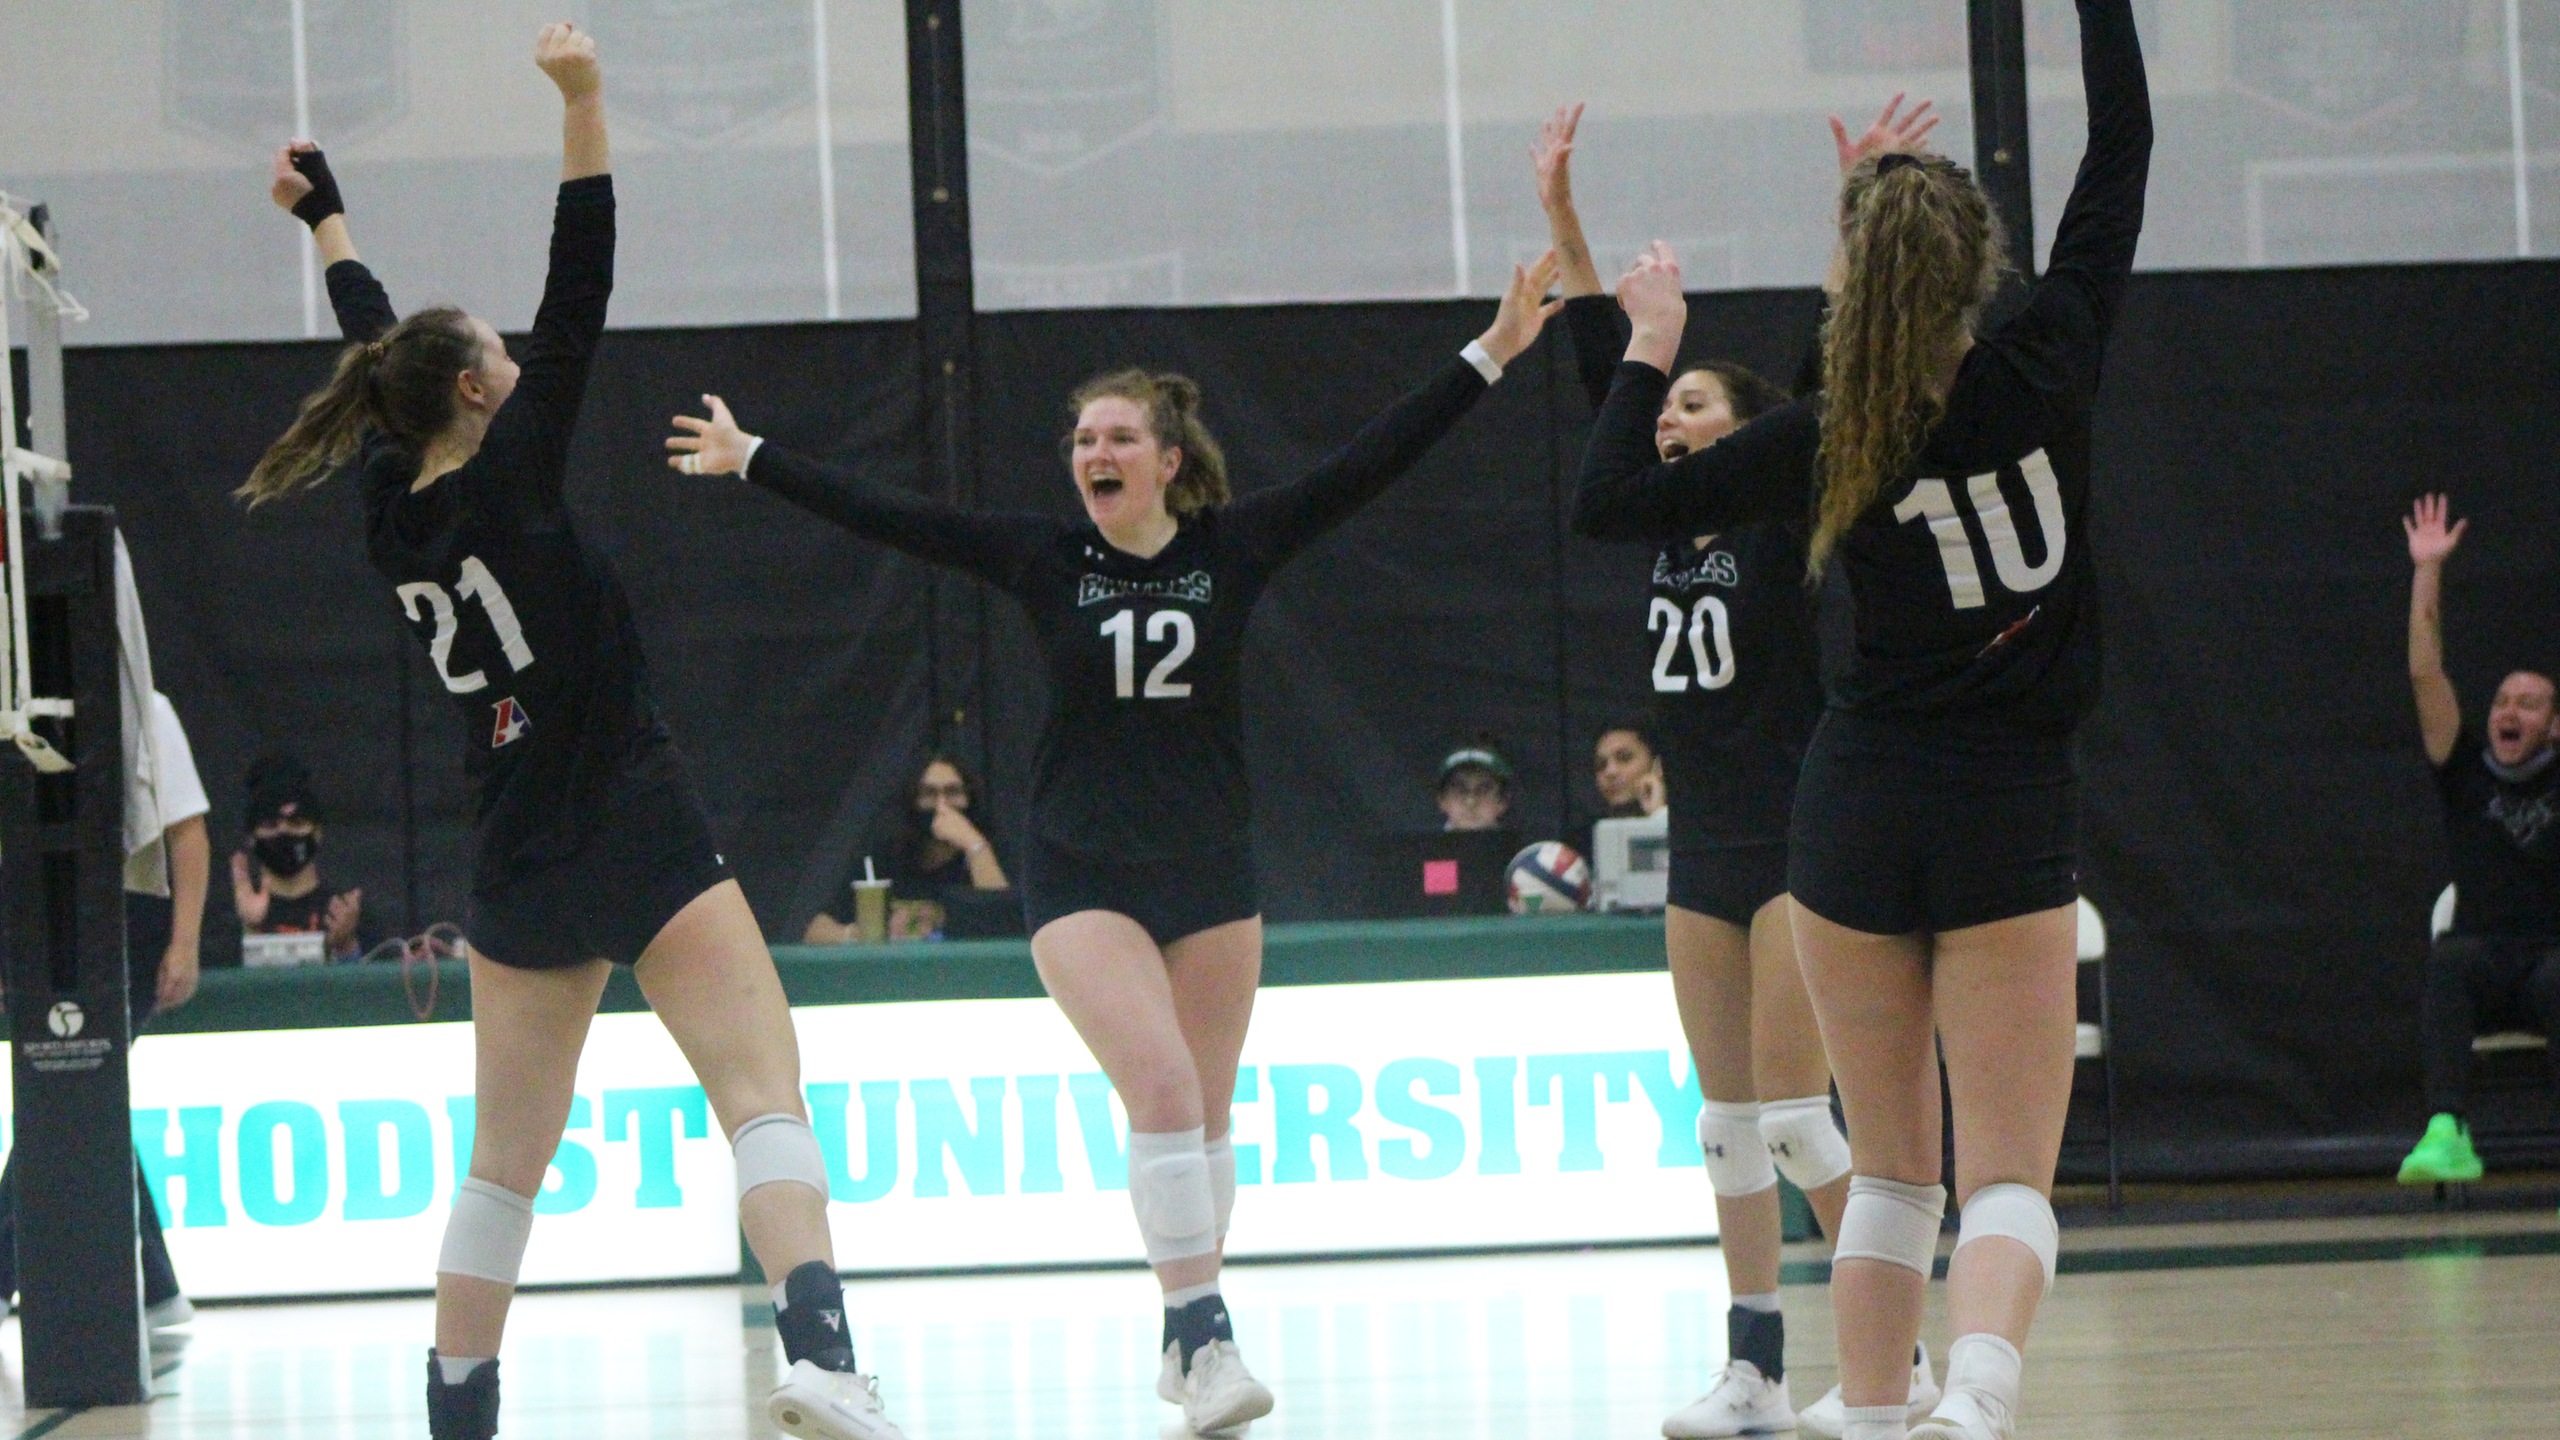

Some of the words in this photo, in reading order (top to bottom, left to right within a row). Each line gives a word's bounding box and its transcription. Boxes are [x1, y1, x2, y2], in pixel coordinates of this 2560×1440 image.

[1893, 447, 2066, 610] 10
[397, 555, 535, 694] 21
[1100, 609, 1196, 697] 12
[1647, 595, 1735, 692] 20
[806, 1049, 1706, 1203] UNIVRSITY
